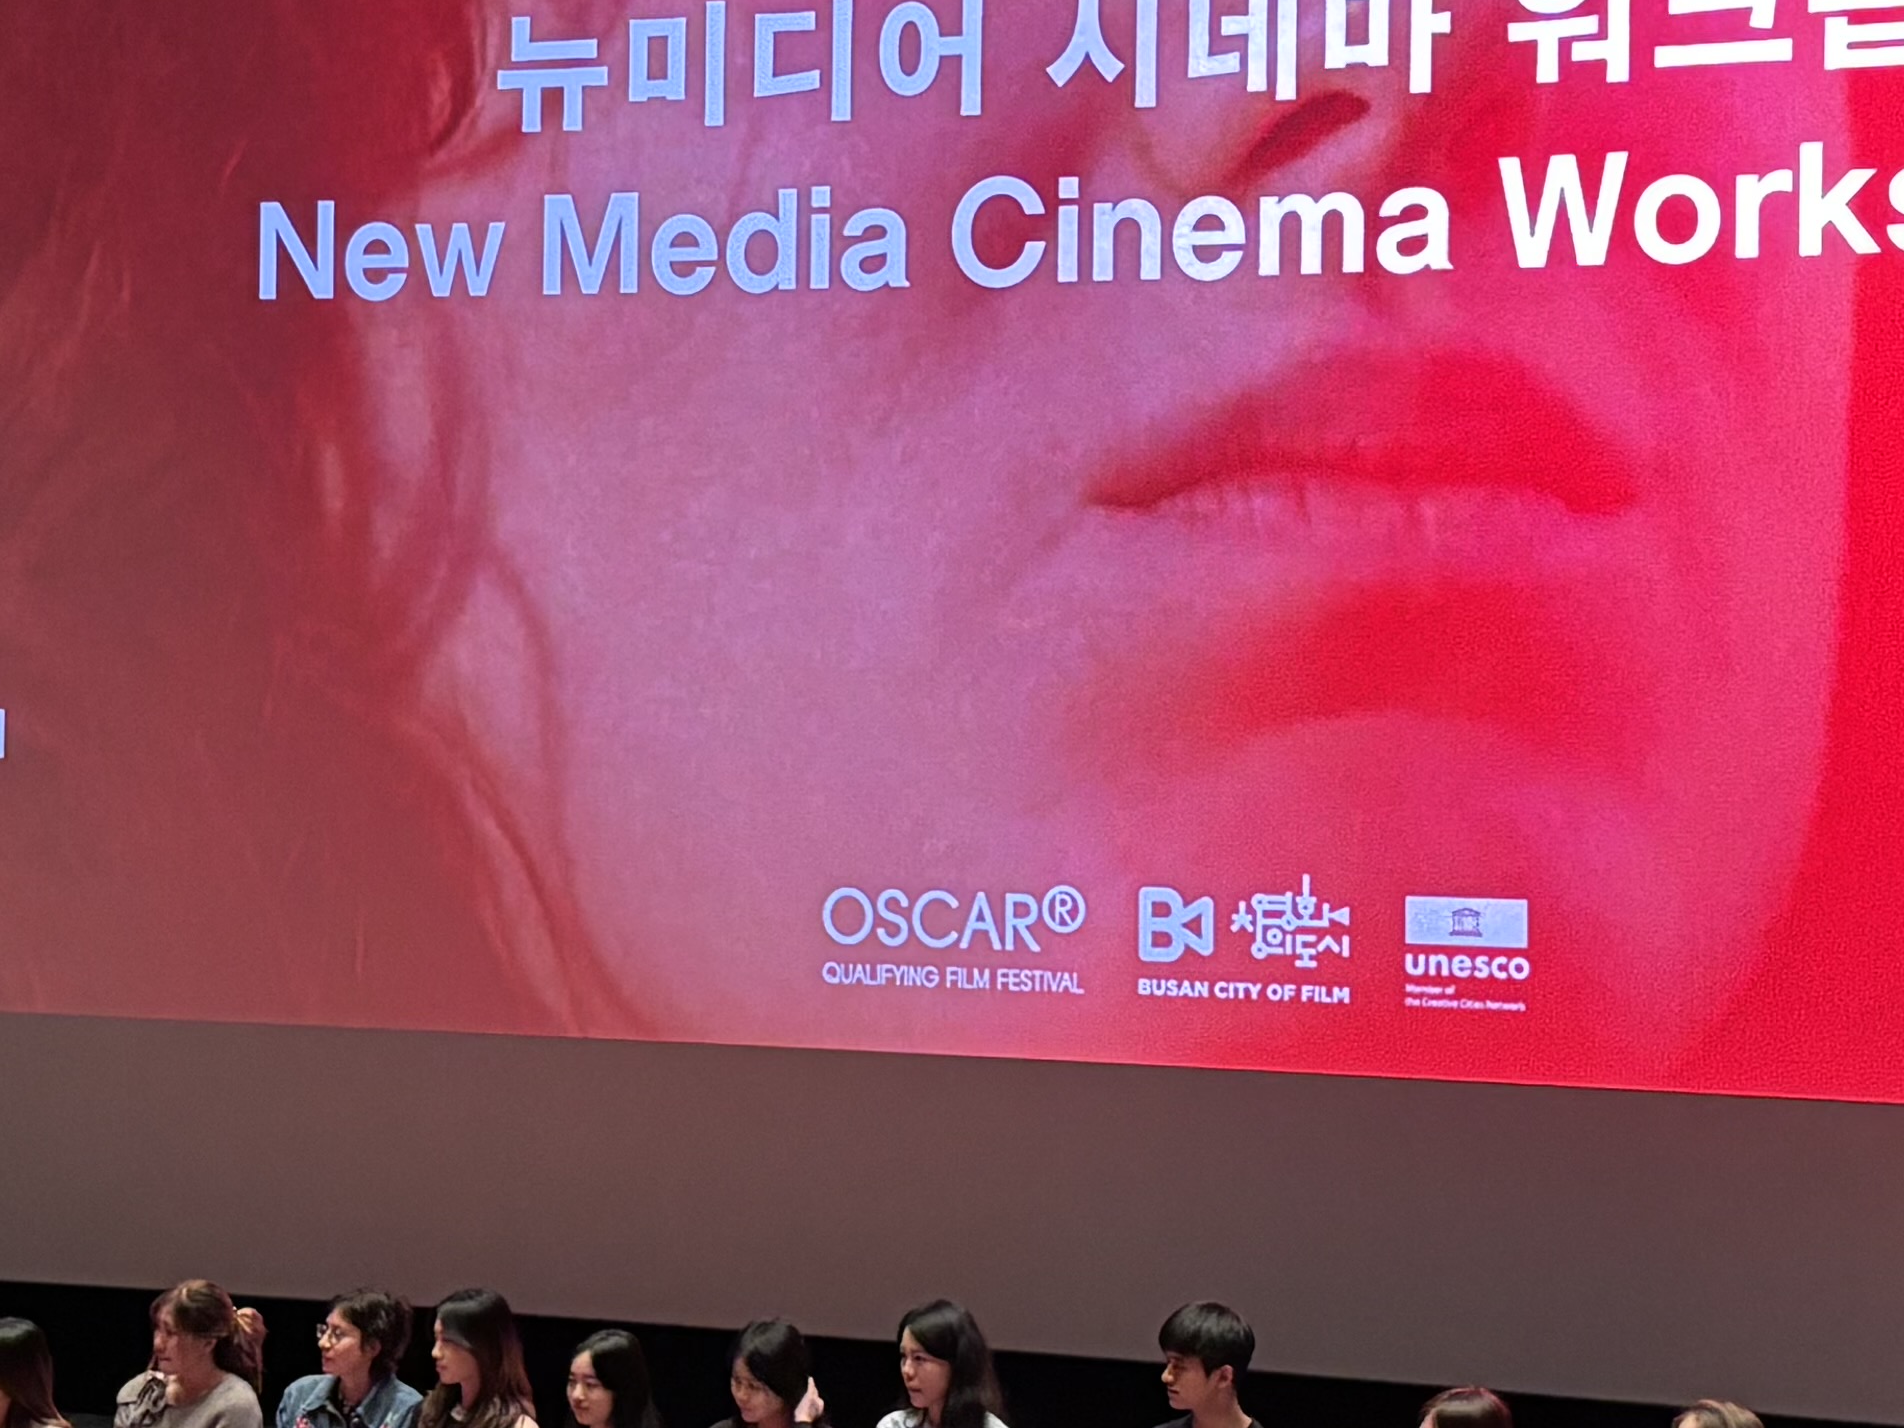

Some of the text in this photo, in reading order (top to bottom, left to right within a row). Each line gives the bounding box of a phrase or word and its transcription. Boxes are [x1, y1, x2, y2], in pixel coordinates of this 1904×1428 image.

[258, 200, 605, 300] New
[542, 185, 911, 295] Media
[950, 174, 1453, 288] Cinema
[821, 961, 1085, 995] QUALIFYING FILM FESTIVAL
[1404, 952, 1531, 981] unesco
[1137, 978, 1351, 1004] BUSAN CITY OF FILM
